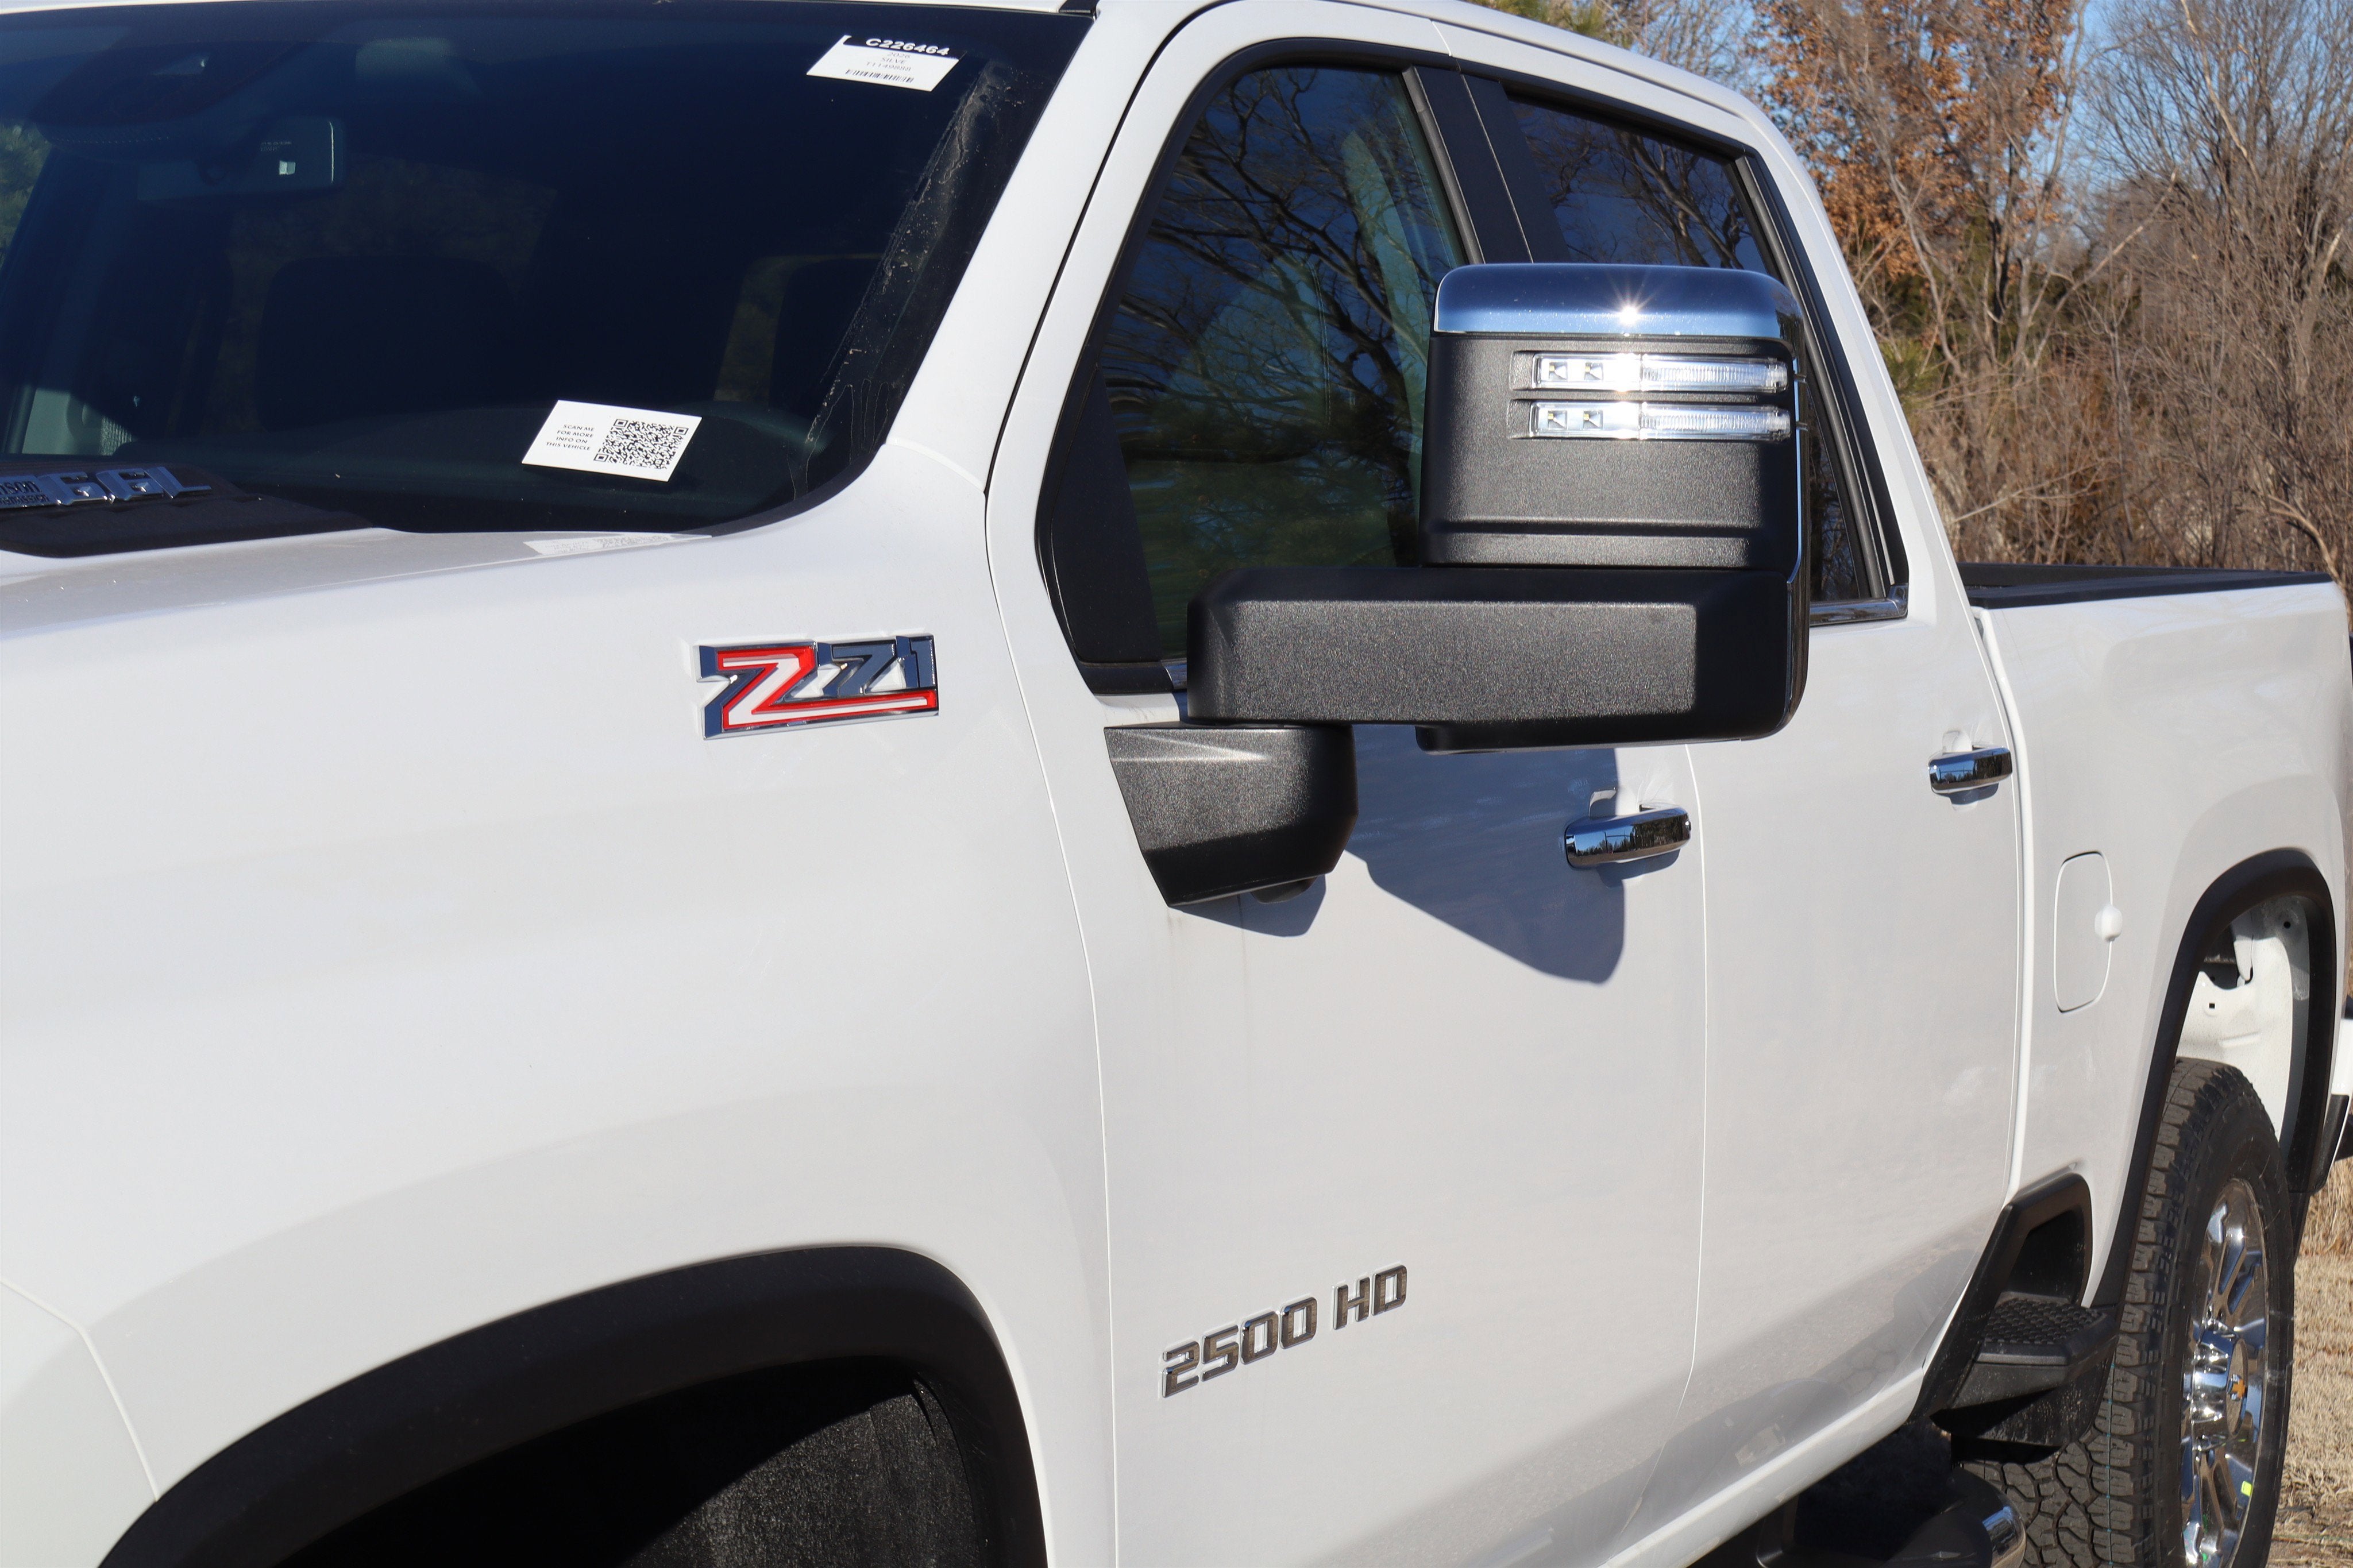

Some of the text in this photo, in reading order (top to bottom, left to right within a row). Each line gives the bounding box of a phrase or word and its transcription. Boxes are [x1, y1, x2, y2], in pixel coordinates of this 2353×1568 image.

[866, 38, 950, 56] C226464
[699, 634, 939, 740] Z71
[1161, 1265, 1407, 1398] 2500 HD
